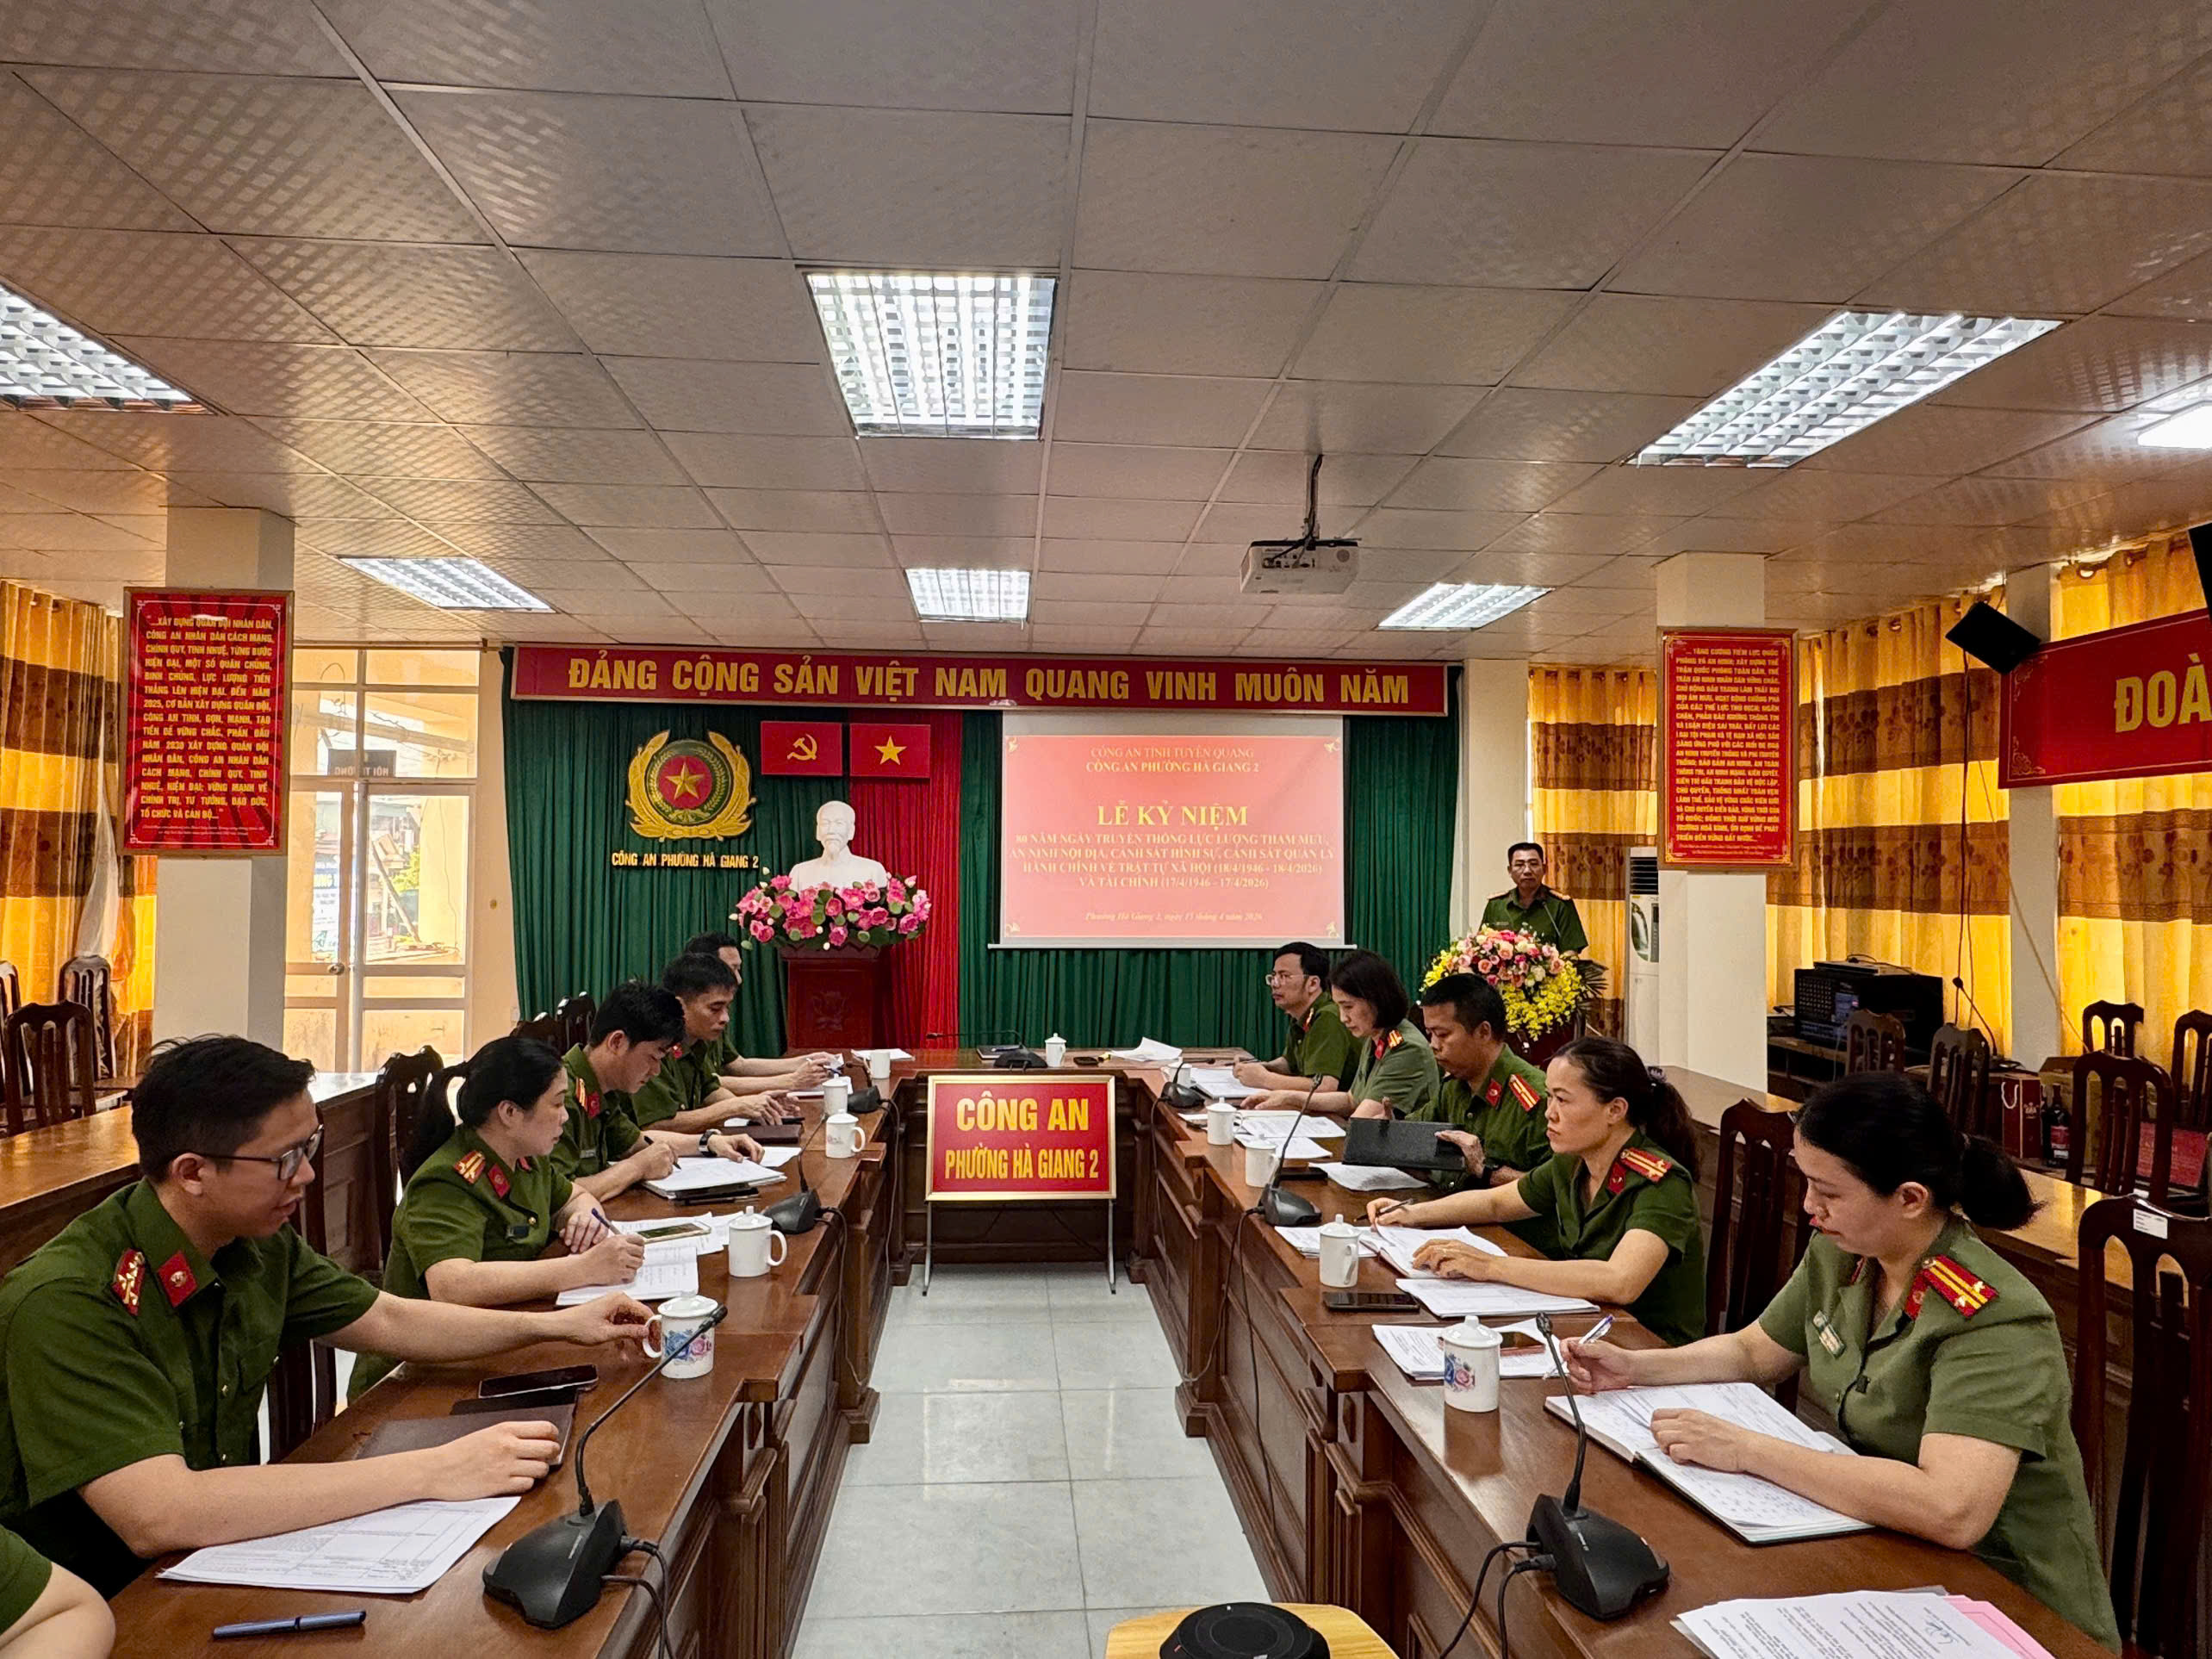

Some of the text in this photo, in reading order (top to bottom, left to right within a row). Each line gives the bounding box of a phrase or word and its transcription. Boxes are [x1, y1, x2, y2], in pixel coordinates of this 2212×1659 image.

[569, 649, 1408, 703] ĐẢNG CỘNG SẢN VIỆT NAM QUANG VINH MUÔN NĂM
[1090, 743, 1254, 760] CÔNG AN TỈNH TUYÊN QUANG
[1086, 758, 1259, 773] CÔNG AN PHƯỜNG HÀ GIANG 2
[1097, 799, 1248, 831] LỄ KỶ NIỆM
[1031, 832, 1057, 844] NĂM
[1059, 832, 1092, 844] NGÀY
[1096, 832, 1142, 844] TRUYỀN
[1146, 832, 1186, 844] THỐNG
[1189, 834, 1216, 846] LỰC
[1217, 834, 1258, 847] LƯỢNG
[1261, 834, 1296, 844] THAM
[1299, 833, 1330, 846] MƯU,
[612, 850, 759, 868] CÔNG AN PHƯỜNG HÀ GIANG 2
[1079, 875, 1096, 887] VÀ
[1098, 875, 1118, 887] TÀI
[1121, 875, 1158, 887] CHÍNH
[1160, 877, 1210, 889] (17/4/1946
[1220, 877, 1269, 889] 17/4/2026)
[956, 1090, 1089, 1131] CÔNG AN
[945, 1142, 1099, 1179] PHƯỜNG HÀ GIANG 2
